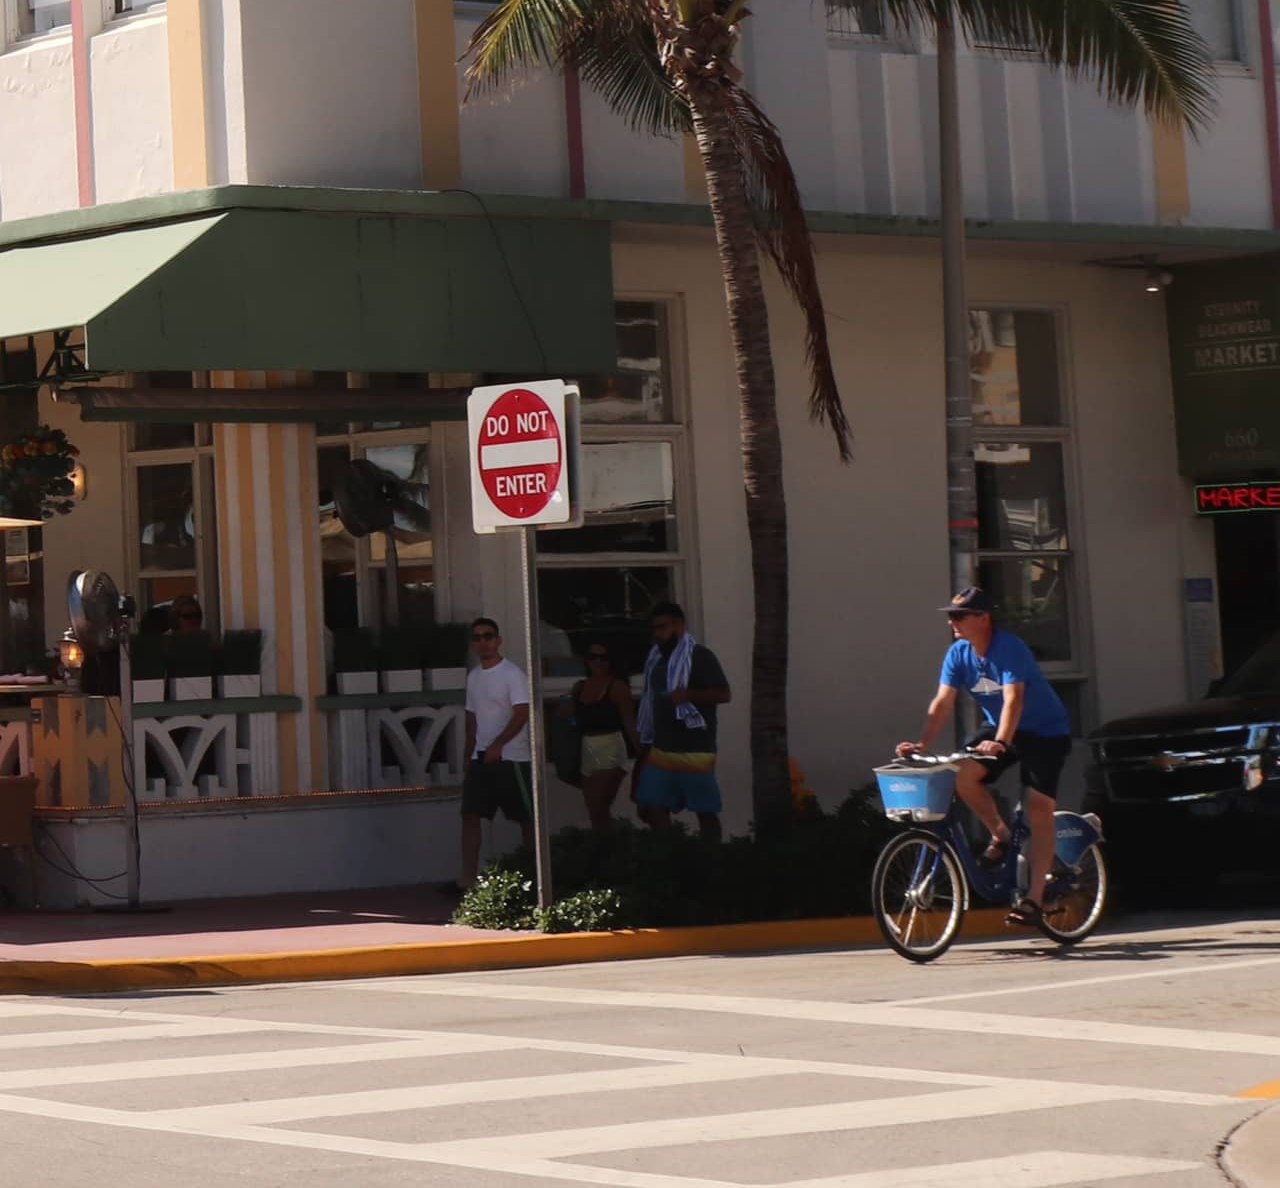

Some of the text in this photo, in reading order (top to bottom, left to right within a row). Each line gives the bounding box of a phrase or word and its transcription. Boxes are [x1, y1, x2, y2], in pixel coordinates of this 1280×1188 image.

[1194, 342, 1280, 368] MARKET
[486, 410, 549, 437] DO NOT
[495, 473, 547, 497] ENTER
[1199, 487, 1280, 509] MARKE
